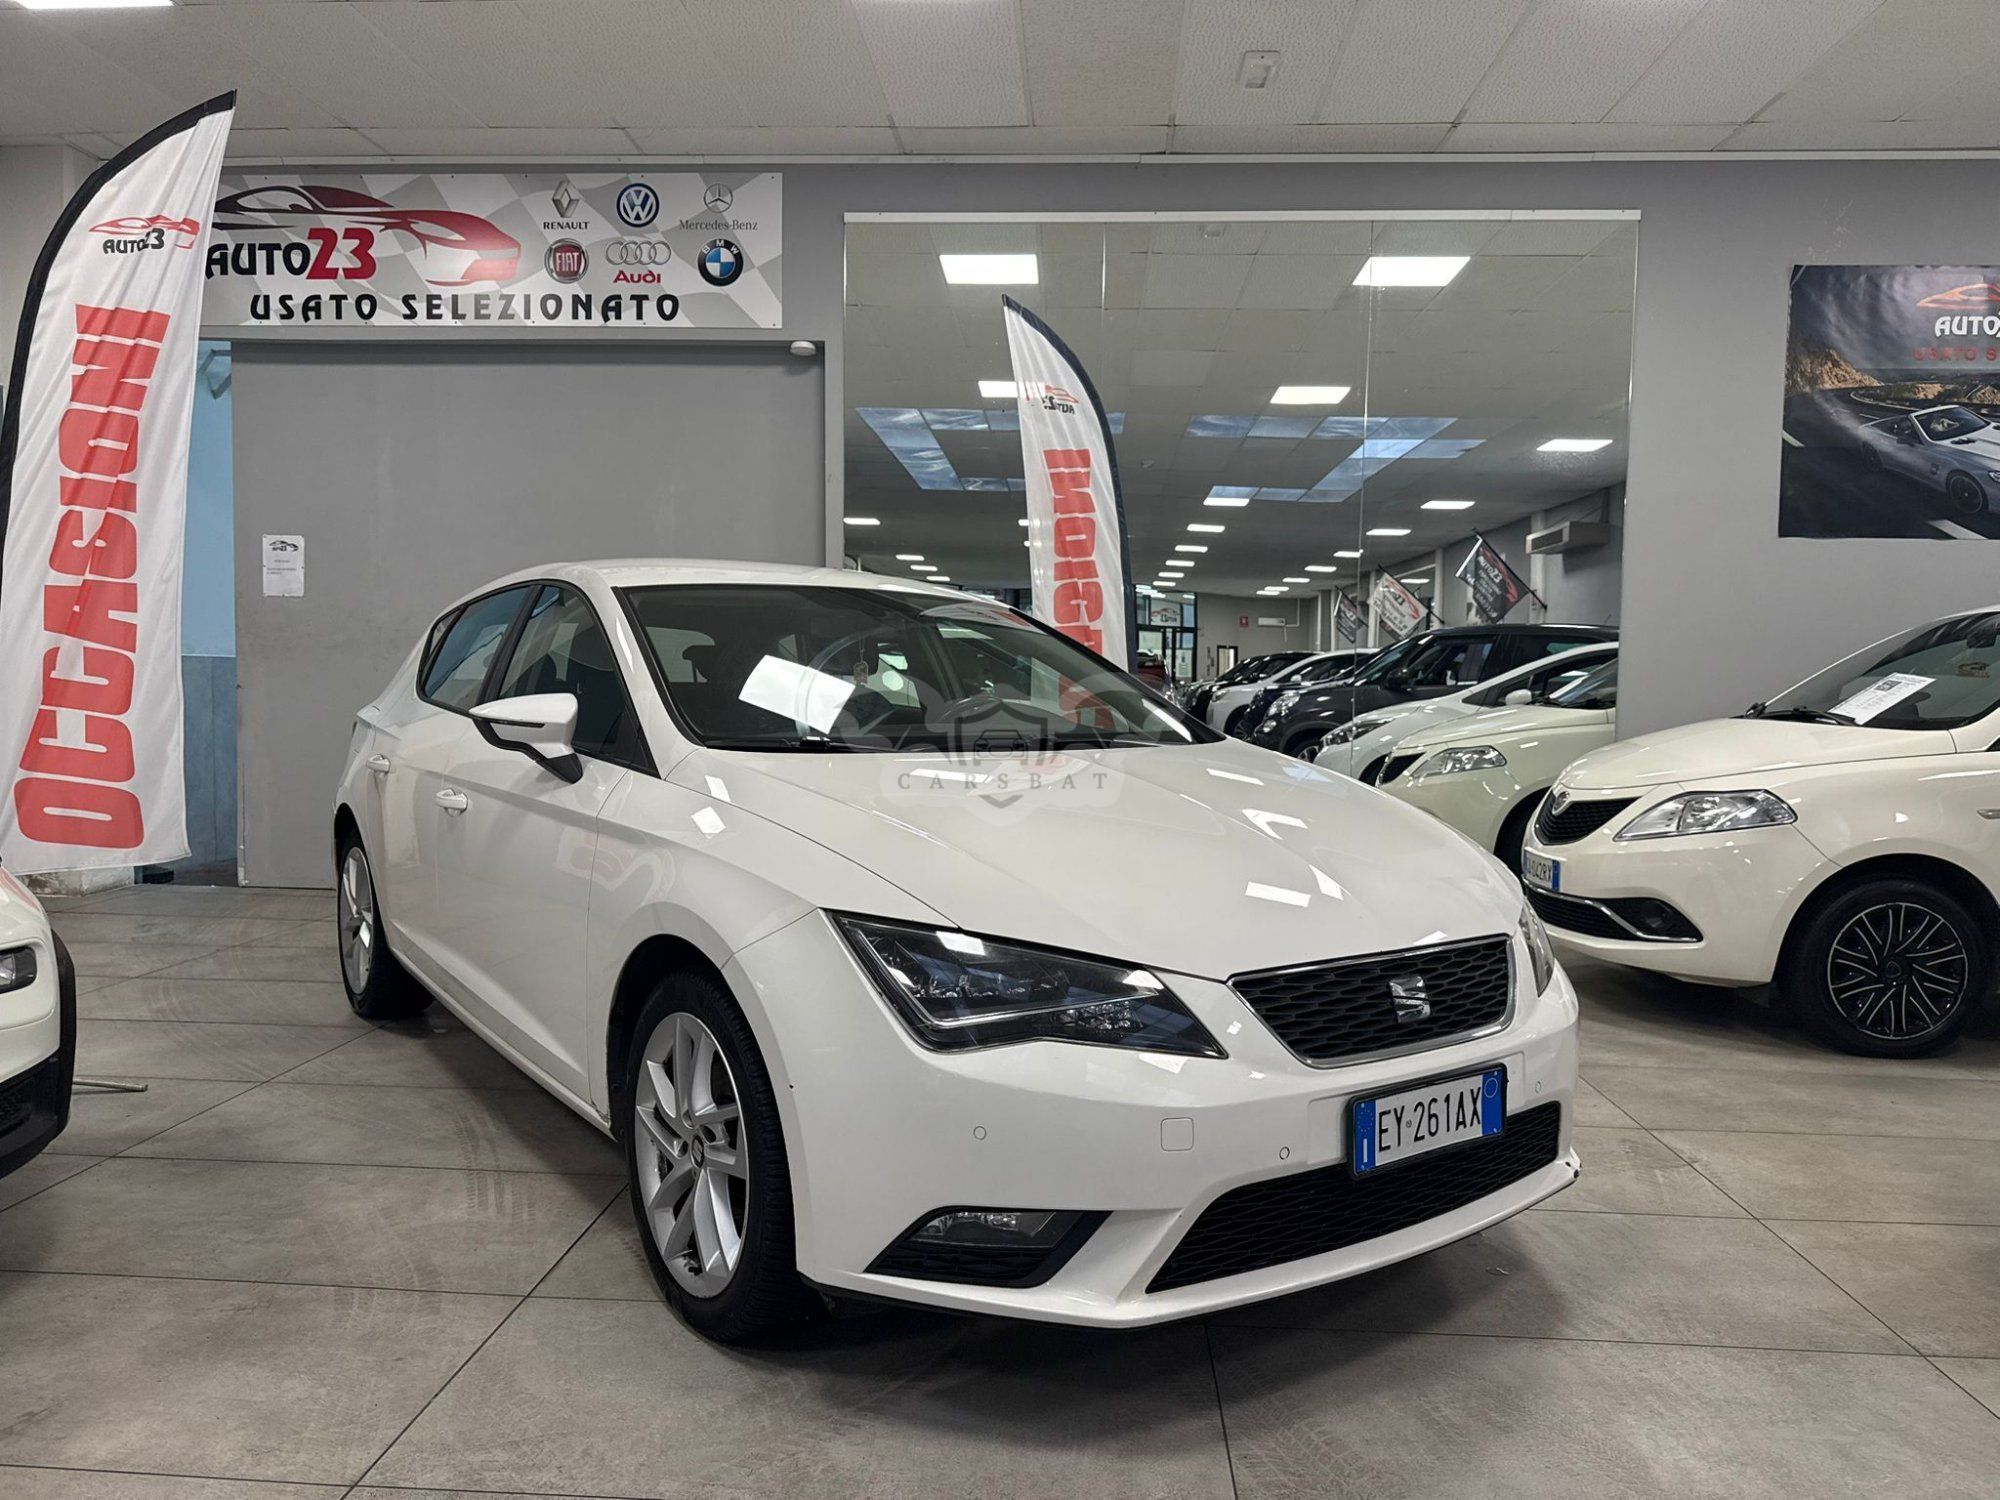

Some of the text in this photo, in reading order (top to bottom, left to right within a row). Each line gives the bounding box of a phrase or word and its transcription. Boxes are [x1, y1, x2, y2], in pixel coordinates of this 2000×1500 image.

[543, 221, 590, 230] RENAULT
[679, 219, 758, 231] Mercedes-Benz
[204, 227, 377, 280] AUTO23
[701, 239, 740, 256] BMW
[555, 252, 580, 273] FIAT
[612, 269, 662, 284] Audi
[250, 293, 680, 323] USATO SELEZIONATO
[13, 303, 171, 850] OCCASIONI
[1378, 1104, 1405, 1152] EY
[1413, 1086, 1481, 1142] 261AX
